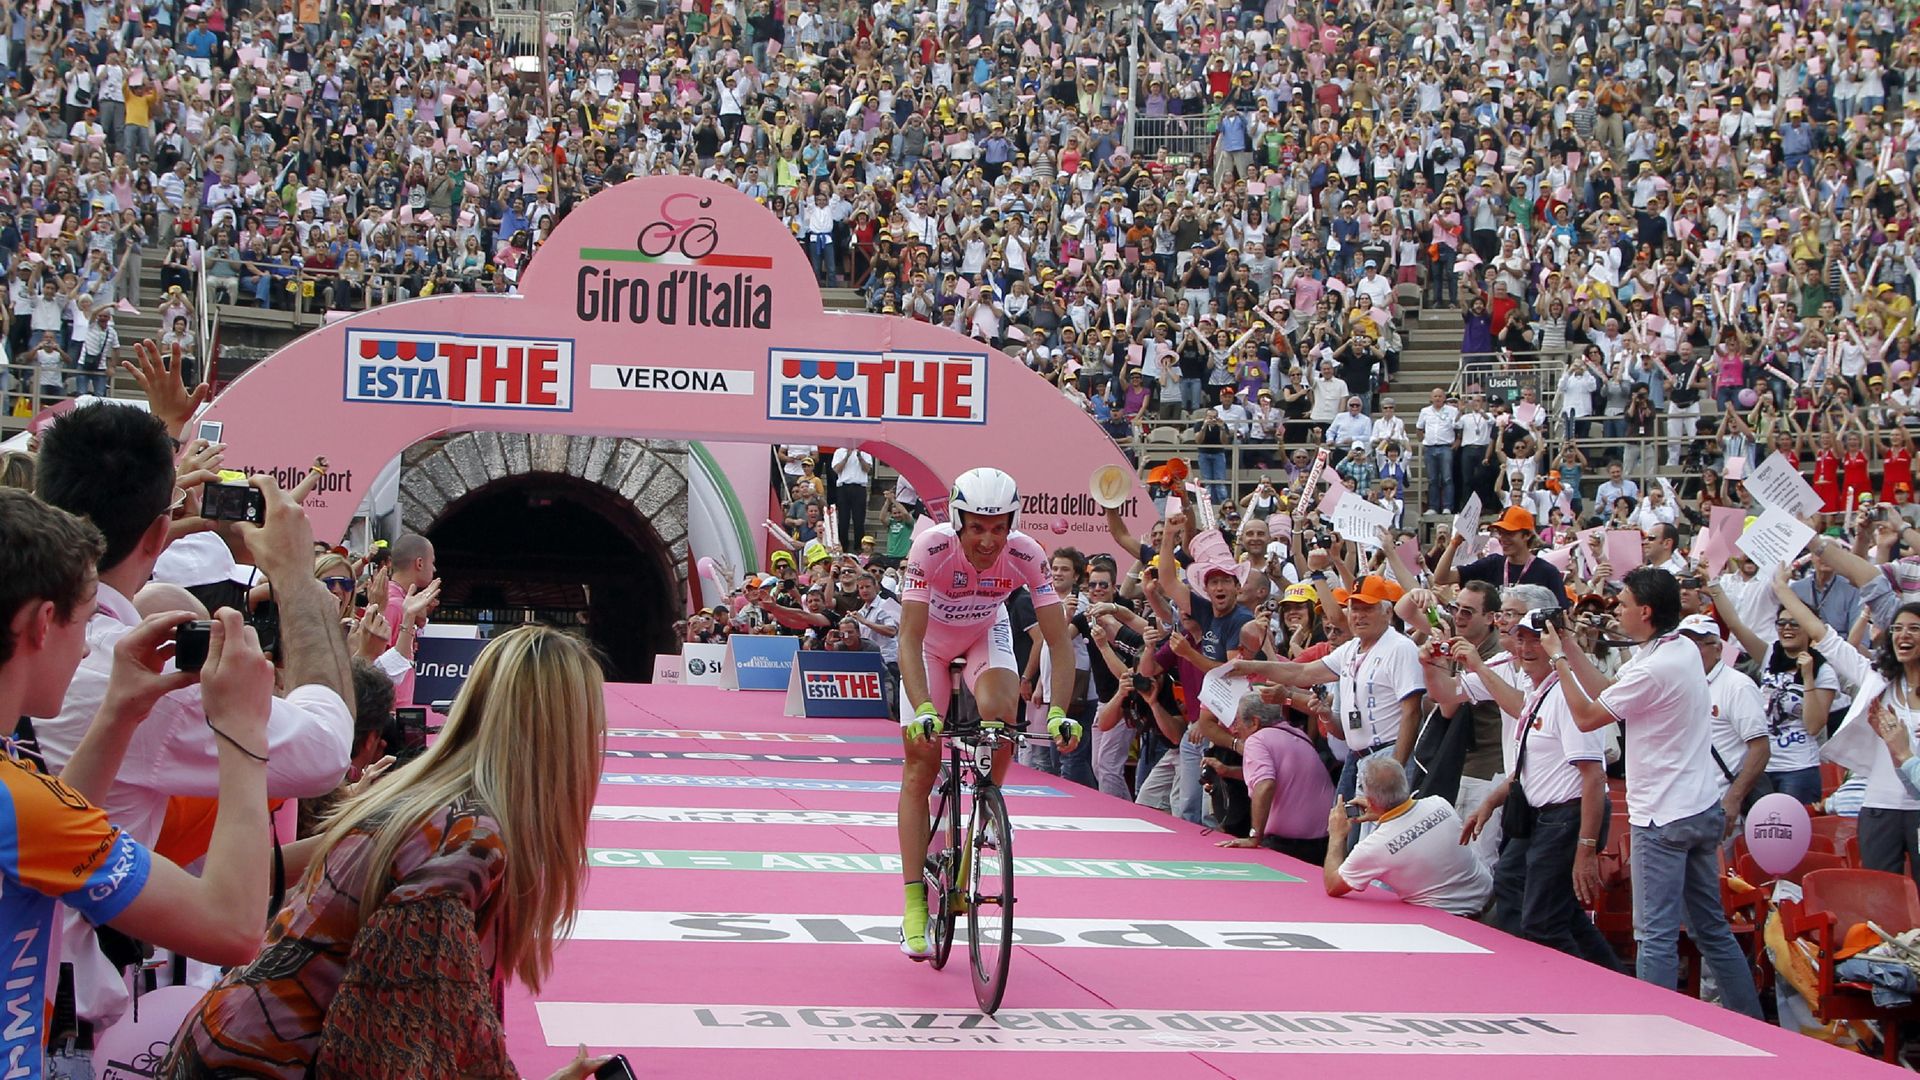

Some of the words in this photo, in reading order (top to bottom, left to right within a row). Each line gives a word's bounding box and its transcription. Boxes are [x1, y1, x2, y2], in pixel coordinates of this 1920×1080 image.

[577, 265, 649, 324] Giro
[657, 269, 772, 329] d'Italia
[617, 367, 728, 392] VERONA
[1489, 378, 1518, 388] Uscita
[976, 506, 1003, 514] MET
[1019, 493, 1058, 515] zetta
[1061, 493, 1096, 516] dello
[1021, 521, 1027, 530] il
[1028, 523, 1049, 531] rosa
[1071, 522, 1094, 532] della
[1096, 524, 1110, 533] vit
[415, 662, 473, 678] unieu
[709, 659, 723, 673] Šk
[754, 660, 793, 668] MEDIOLANU
[668, 669, 680, 679] Gazz
[1754, 827, 1767, 839] Giro
[88, 830, 136, 902] GARM
[593, 850, 664, 866] CI
[976, 858, 1178, 878] ULITA
[1156, 1012, 1340, 1033] dello
[1341, 1014, 1577, 1037] Sport
[814, 1033, 956, 1044] Tutto
[1013, 1037, 1128, 1046] rosa
[1252, 1037, 1369, 1048] della
[1390, 1038, 1486, 1048] vita
